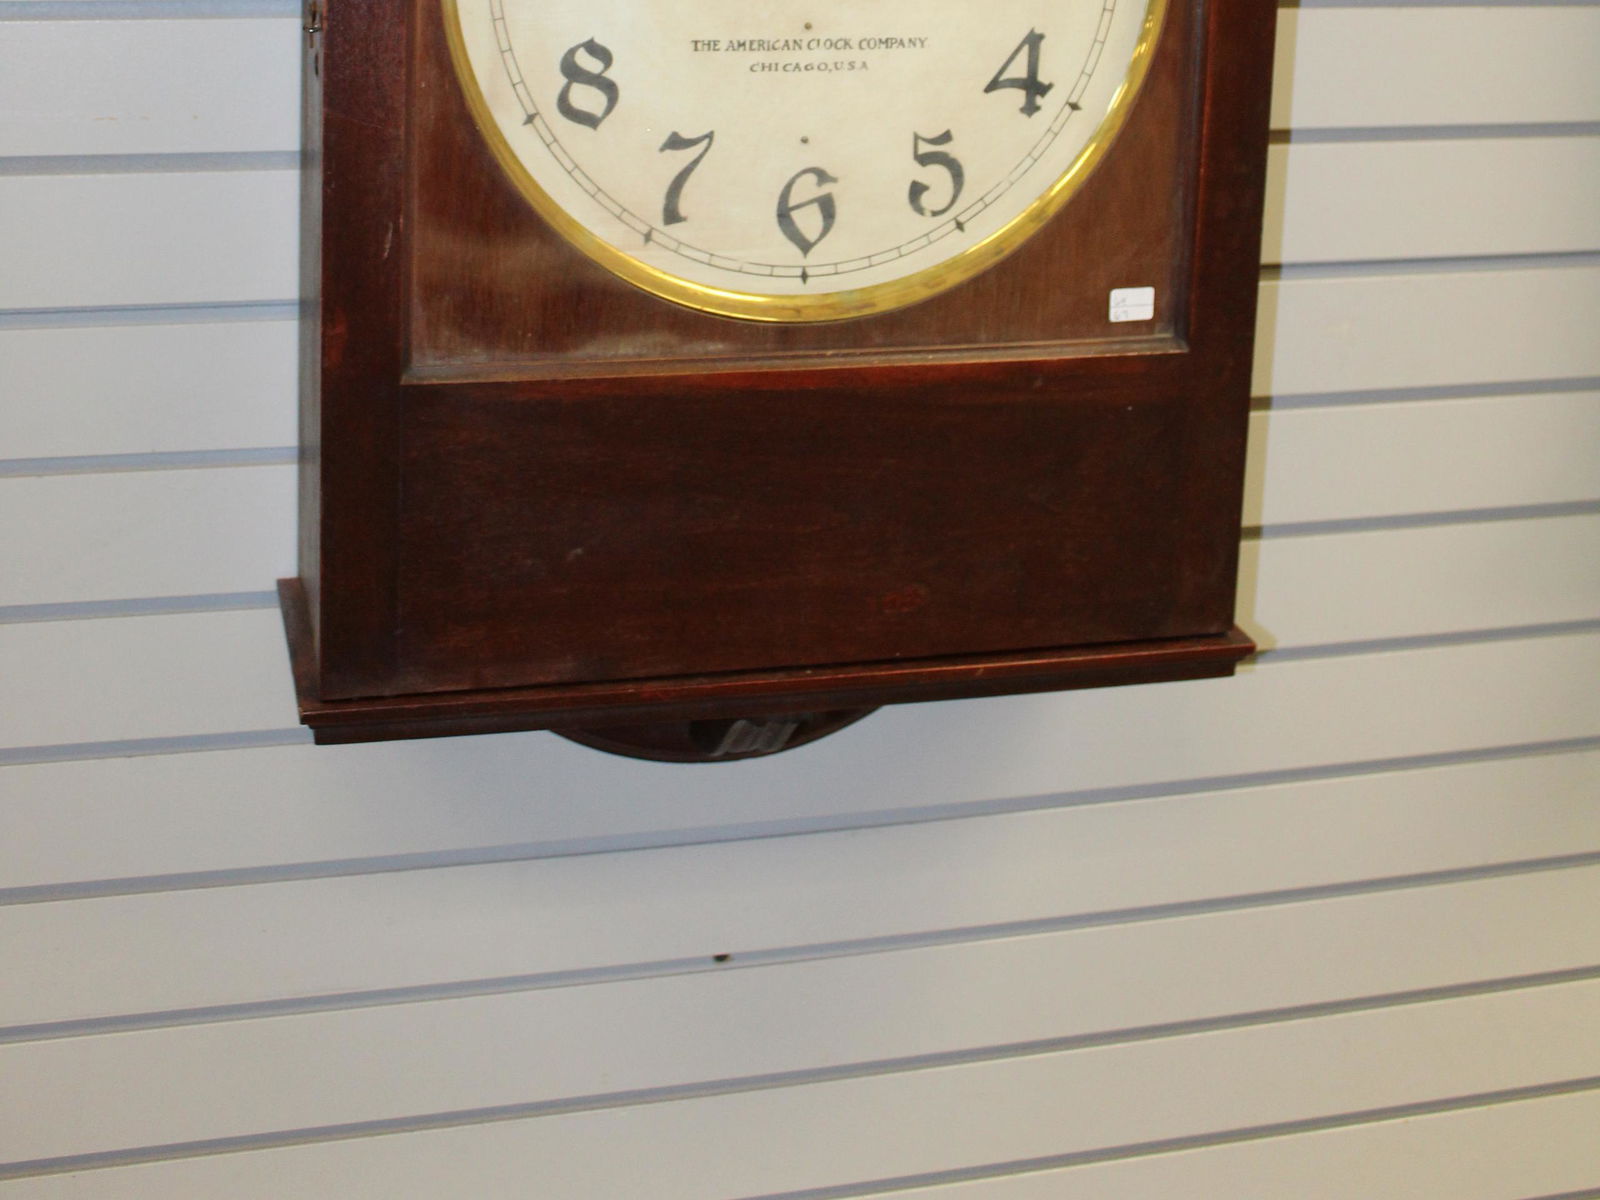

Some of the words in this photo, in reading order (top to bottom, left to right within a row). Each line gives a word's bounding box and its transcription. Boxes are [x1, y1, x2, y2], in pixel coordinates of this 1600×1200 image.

[556, 38, 620, 130] 8
[691, 39, 720, 52] THE
[725, 38, 803, 52] AMERICAN
[807, 37, 853, 50] CLOCK
[858, 36, 928, 50] COMPANY
[983, 27, 1055, 118] 4
[658, 129, 714, 226] 7
[776, 165, 839, 258] 6
[908, 129, 965, 218] 5
